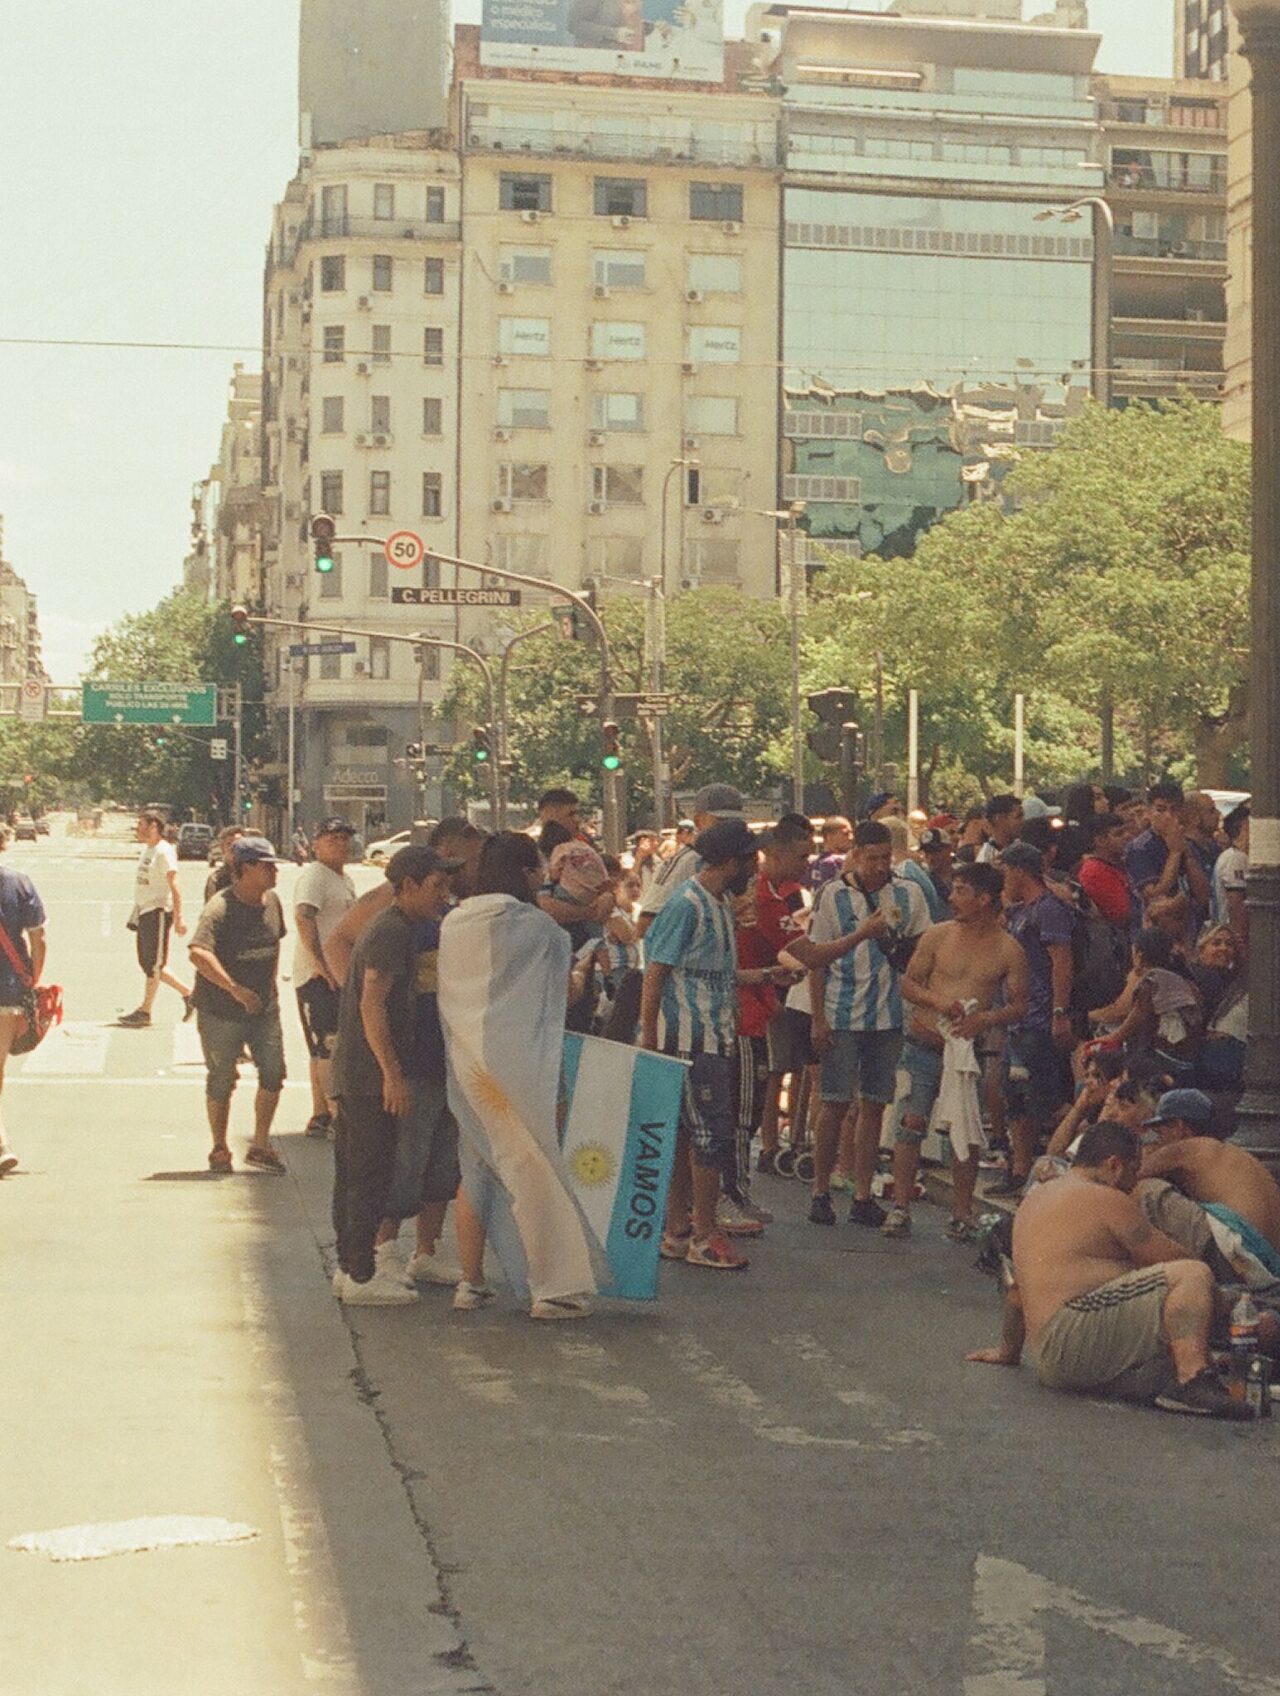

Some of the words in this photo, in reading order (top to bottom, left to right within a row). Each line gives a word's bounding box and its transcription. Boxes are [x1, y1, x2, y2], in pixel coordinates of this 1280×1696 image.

[394, 542, 416, 558] 50
[420, 590, 511, 604] PELLEGRINI
[624, 1121, 665, 1241] VAMOS
